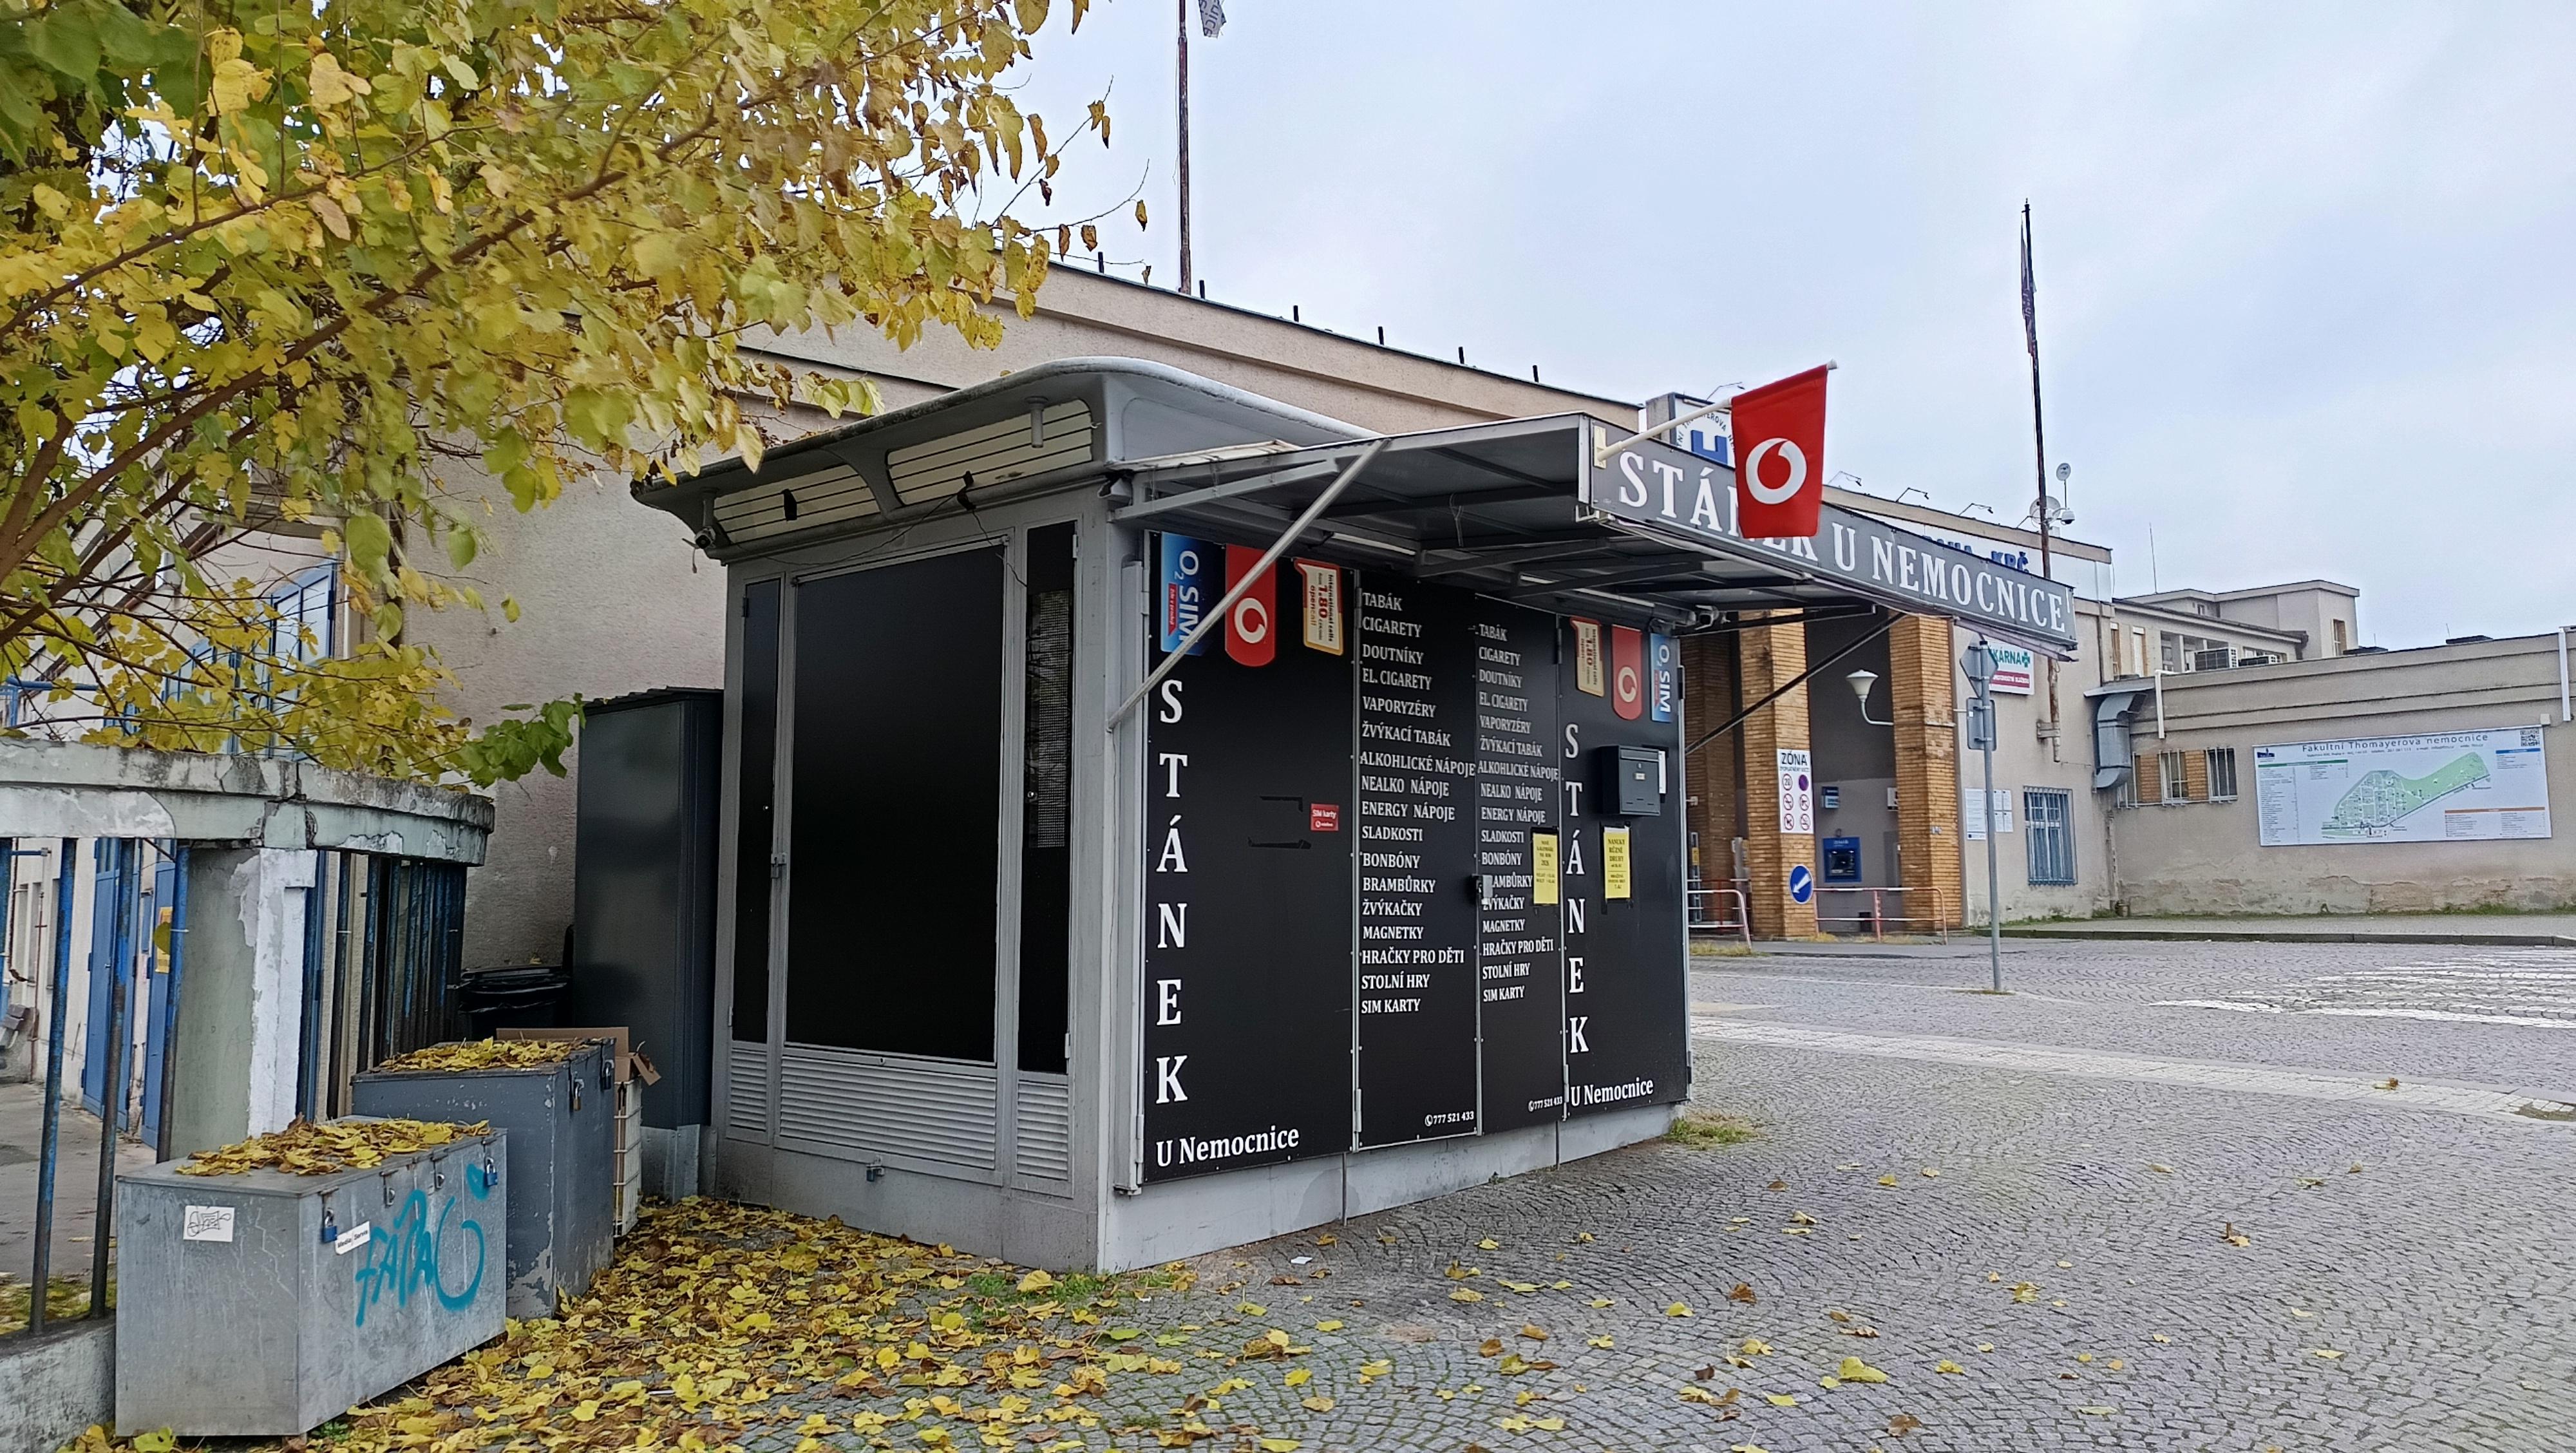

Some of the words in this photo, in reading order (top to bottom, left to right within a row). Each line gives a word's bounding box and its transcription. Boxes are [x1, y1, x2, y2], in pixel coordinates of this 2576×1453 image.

[1619, 451, 1818, 562] STÁ
[1832, 522, 1857, 571] U
[1871, 535, 2067, 633] NEMOCNICE
[1309, 585, 1318, 626] opencall
[1318, 585, 1328, 619] 1.80
[1363, 592, 1402, 612] TABÁK
[1179, 585, 1198, 642] SIM
[1362, 616, 1422, 638] CIGARETY
[1480, 623, 1508, 641] TABÁK
[1362, 643, 1424, 665] DOUTNÍKY
[1479, 646, 1520, 667] CIGARETY
[1362, 668, 1379, 685] EL.
[1380, 670, 1432, 691] CIGARETY
[1479, 669, 1523, 689] DOUTNÍKY
[1660, 670, 1671, 712] SIM
[1362, 696, 1437, 718] VAPORYZÉRY
[1479, 692, 1492, 707] EL.
[1492, 692, 1528, 712] CIGARETY
[1479, 714, 1531, 735] VAPORYZÉRY
[1362, 722, 1412, 742] ŽVÝKACÍ
[1414, 728, 1451, 748] TABÁK
[2302, 743, 2344, 753] Fakultní
[2349, 739, 2420, 748] Thomayerova
[2427, 734, 2488, 744] nemocnice
[1480, 736, 1515, 753] ŽVÝKACÍ
[1516, 739, 1543, 757] TABÁK
[1360, 752, 1433, 772] ALKOHLICKÉ
[1435, 756, 1476, 778] NÁPOJE
[1781, 750, 1807, 766] ZÓNA
[1478, 760, 1530, 777] ALKOHLICKÉ
[1530, 763, 1558, 782] NÁPOJE
[1361, 775, 1405, 793] NEALKO
[1410, 779, 1450, 798] NÁPOJE
[1481, 783, 1511, 799] NEALKO
[1515, 784, 1542, 802] NÁPOJE
[1361, 801, 1408, 819] ENERGY
[1413, 803, 1455, 823] NÁPOJE
[1481, 806, 1515, 822] ENERGY
[1516, 808, 1546, 824] NÁPOJE
[1362, 825, 1423, 842] SLADKOSTI
[1481, 830, 1524, 843] SLADKOSTI
[1363, 850, 1421, 869] BONBÓNY
[1481, 851, 1522, 866] BONBÓNY
[1363, 875, 1436, 894] BRAMBŮRKY
[1492, 871, 1533, 888] AMBŮRKY
[1565, 723, 1589, 1054] STÁNEK
[1156, 679, 1188, 1104] STÁNEK
[1363, 900, 1423, 918] ŽVÝKAČKY
[1363, 926, 1424, 940] MAGNETKY
[1482, 918, 1526, 933] MAGNETKY
[1482, 940, 1517, 956] HRAČKY
[1518, 940, 1535, 953] PRO
[1536, 936, 1554, 952] DĚTI
[1362, 949, 1410, 965] HRAČKY
[1412, 950, 1437, 964] PRO
[1438, 949, 1465, 964] DĚTI
[1361, 971, 1405, 990] STOLNÍ
[1406, 973, 1431, 989] HRY
[1482, 964, 1513, 980] STOLNÍ
[1513, 962, 1531, 977] HRY
[1483, 989, 1498, 1002] SIM
[1499, 985, 1525, 1001] KARTY
[1361, 1000, 1382, 1014] SIM
[1383, 998, 1421, 1013] KARTY
[1571, 1087, 1582, 1106] U
[1584, 1077, 1654, 1106] Nemocnice
[1433, 1114, 1446, 1126] 777
[1447, 1112, 1461, 1124] 521
[1461, 1110, 1475, 1122] 433
[1155, 1140, 1173, 1168] U
[1179, 1125, 1300, 1165] Nemocnice
